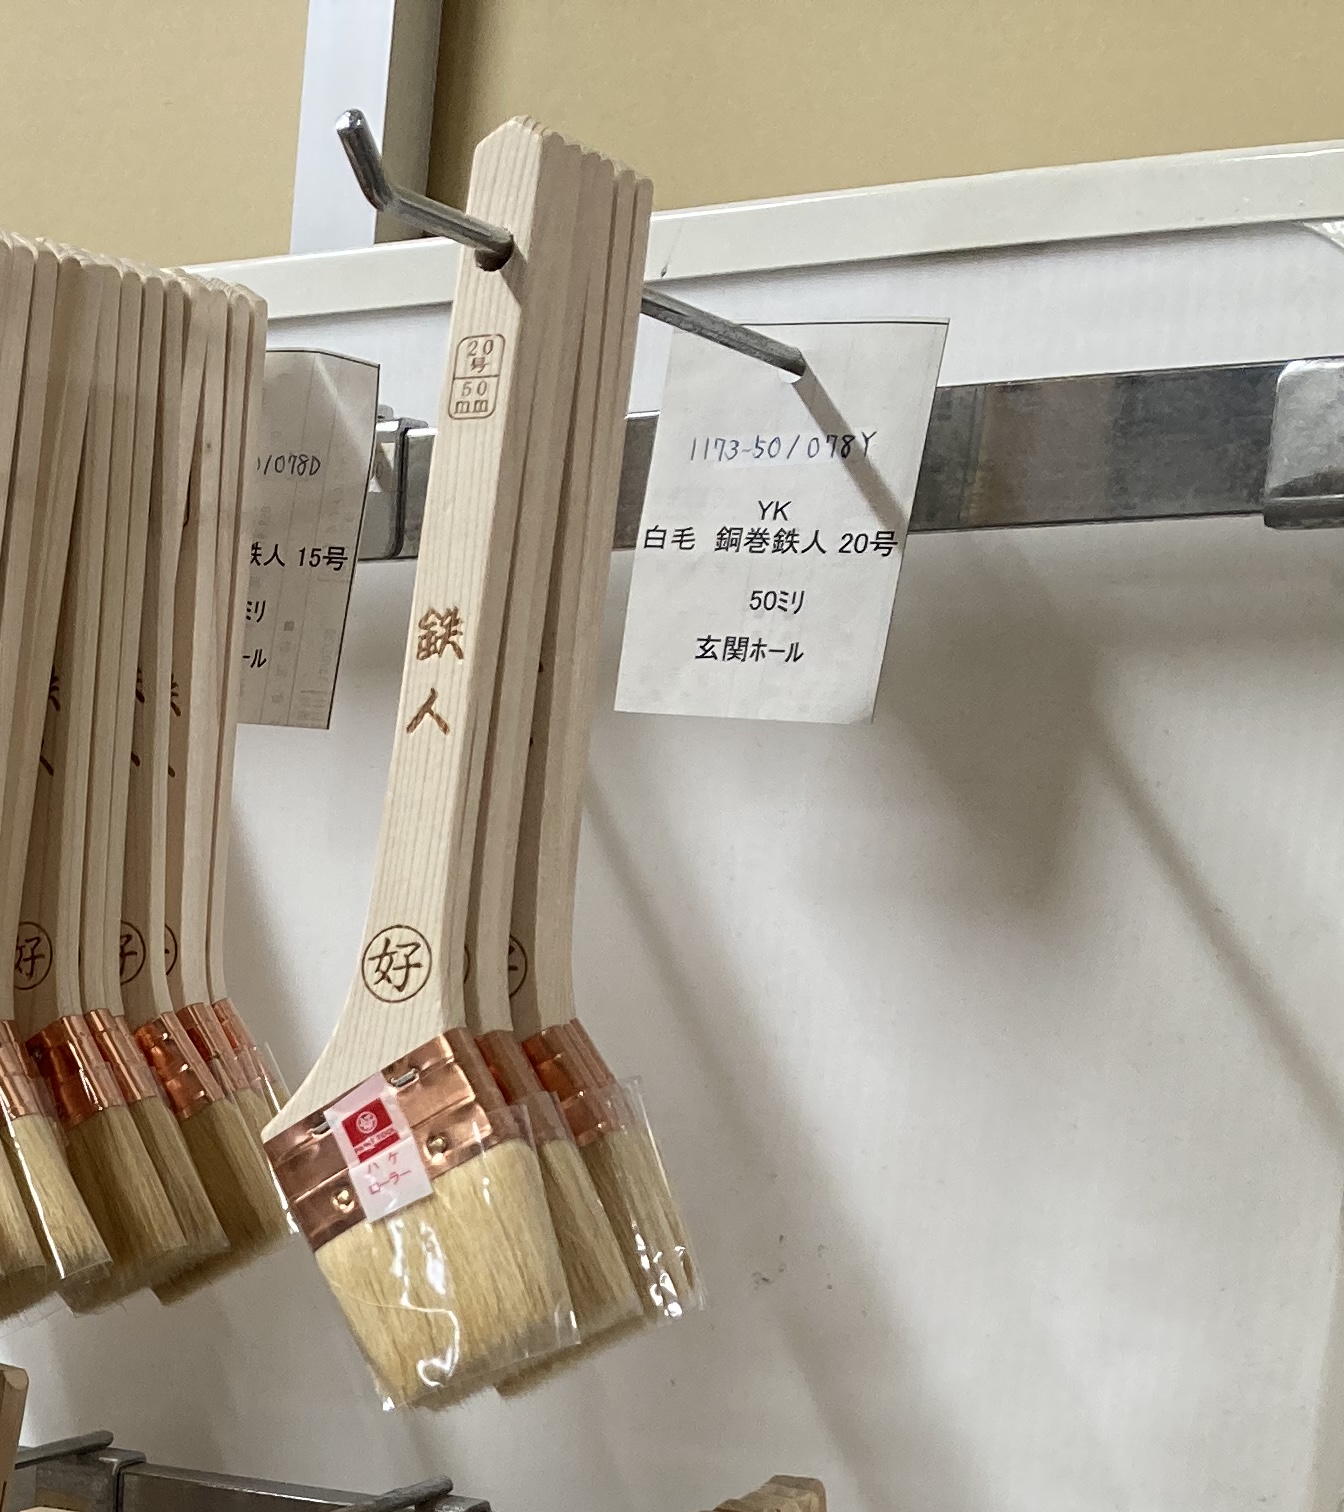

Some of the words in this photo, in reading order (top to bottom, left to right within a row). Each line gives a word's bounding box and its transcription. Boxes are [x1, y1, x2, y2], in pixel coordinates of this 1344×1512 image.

[256, 454, 321, 476] /078D
[758, 500, 792, 521] YK
[643, 524, 696, 551] 白毛
[714, 526, 827, 555] 銅巻鉄人
[838, 530, 898, 557] 20号
[299, 546, 348, 571] 15号
[749, 590, 805, 615] 50ミリ
[695, 634, 804, 663] 玄関ホール
[406, 605, 464, 736] 鉄人
[16, 928, 49, 985] 好
[365, 931, 427, 997] 好
